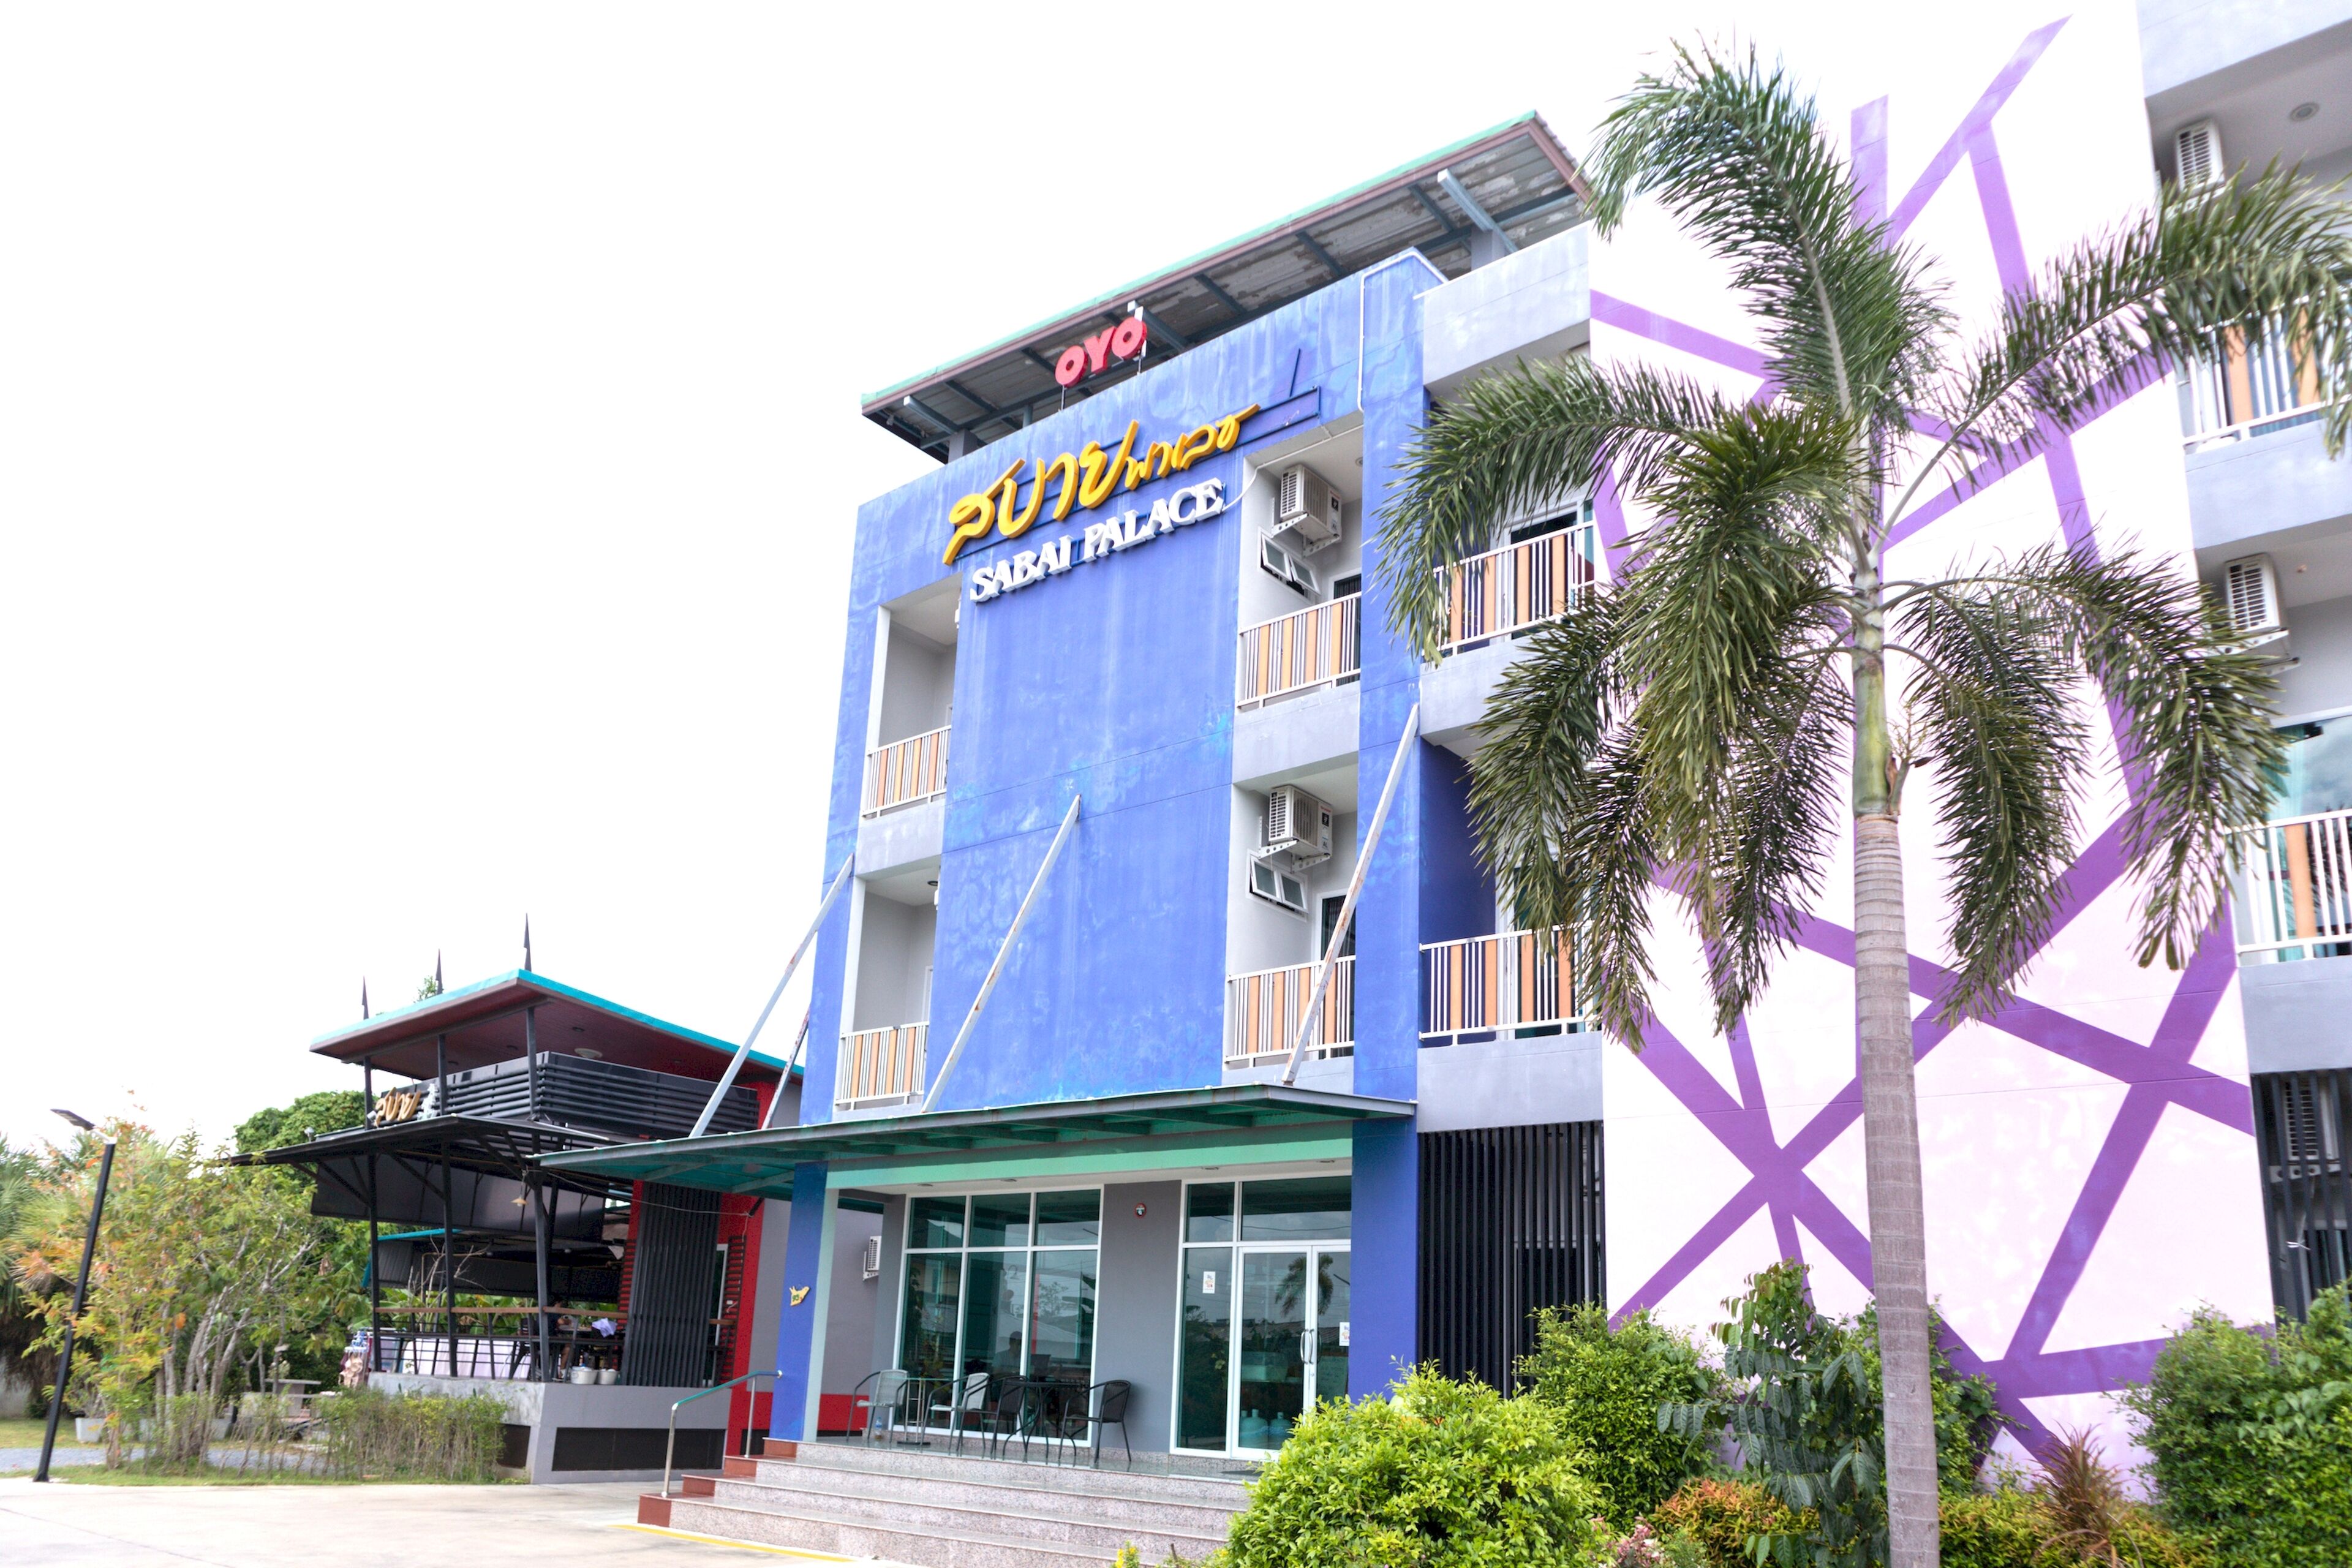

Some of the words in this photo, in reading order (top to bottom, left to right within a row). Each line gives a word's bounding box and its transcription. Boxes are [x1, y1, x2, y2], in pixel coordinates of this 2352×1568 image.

[1055, 316, 1147, 387] OYO
[970, 534, 1074, 603] SABAI
[1082, 477, 1224, 563] PALACE
